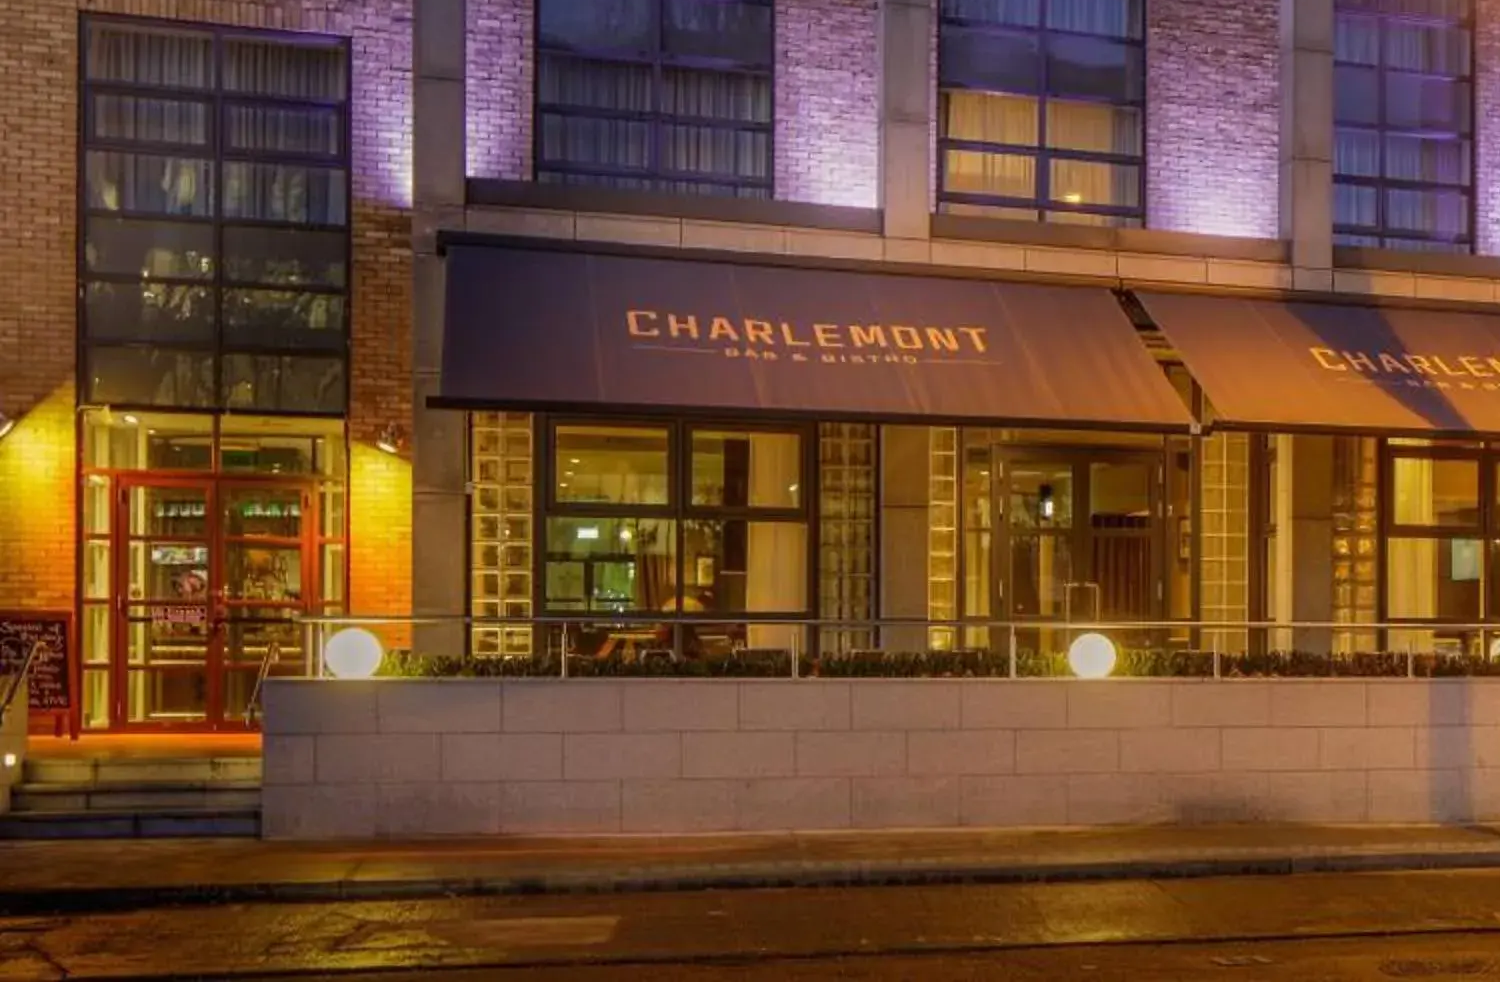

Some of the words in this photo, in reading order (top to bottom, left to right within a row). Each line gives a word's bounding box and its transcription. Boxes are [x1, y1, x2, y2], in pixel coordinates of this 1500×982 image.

[626, 309, 988, 353] CHARLEMONT
[725, 347, 778, 361] BAR
[820, 354, 919, 365] BISTRO
